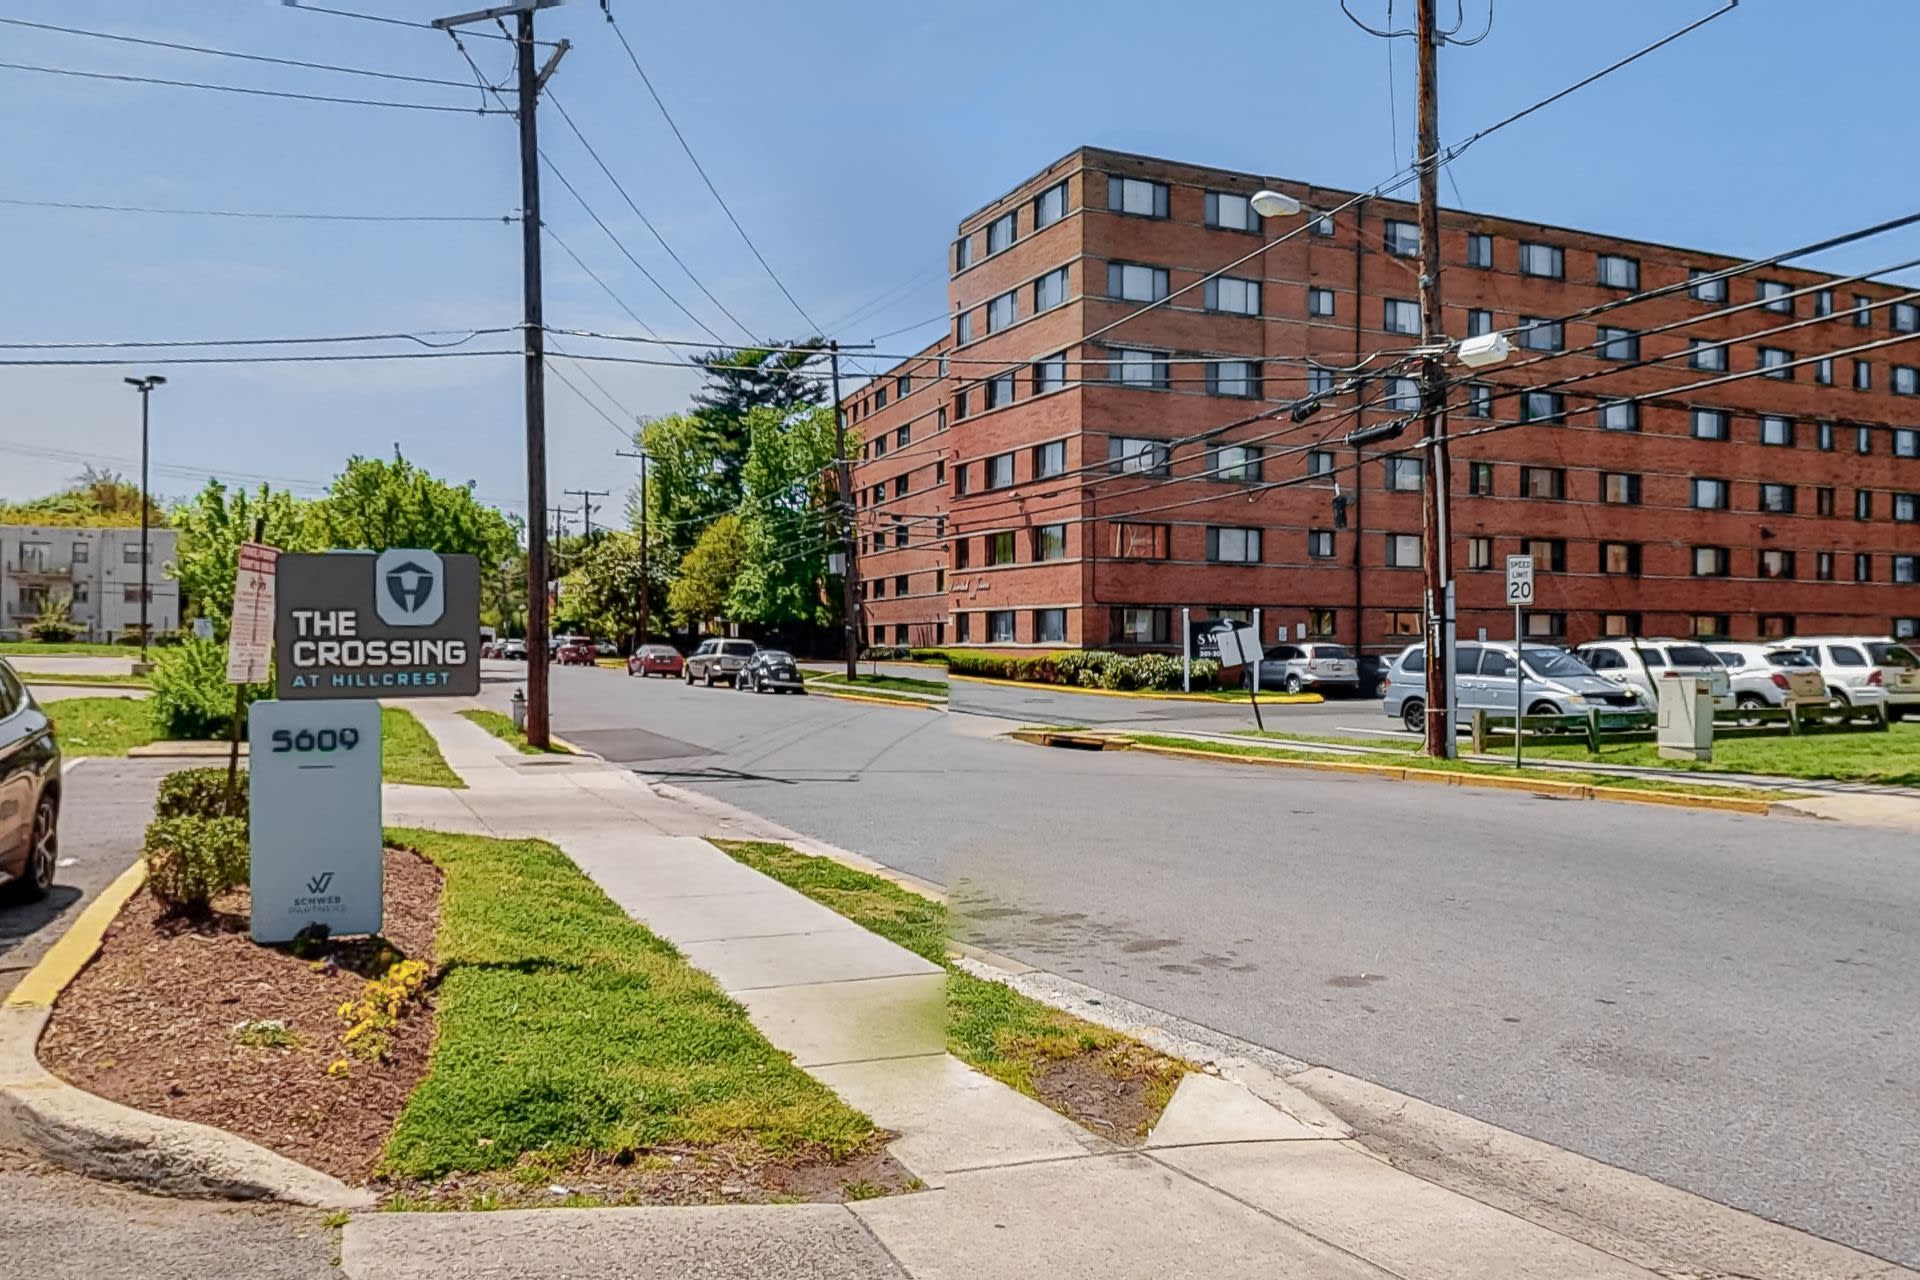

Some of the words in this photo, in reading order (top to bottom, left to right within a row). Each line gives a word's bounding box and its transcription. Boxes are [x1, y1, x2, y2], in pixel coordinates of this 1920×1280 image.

[1510, 581, 1531, 599] 20
[292, 610, 356, 637] THE
[292, 640, 467, 667] CROSSING
[292, 673, 320, 688] AT
[331, 671, 450, 687] HILLCREST
[271, 727, 360, 753] 5609
